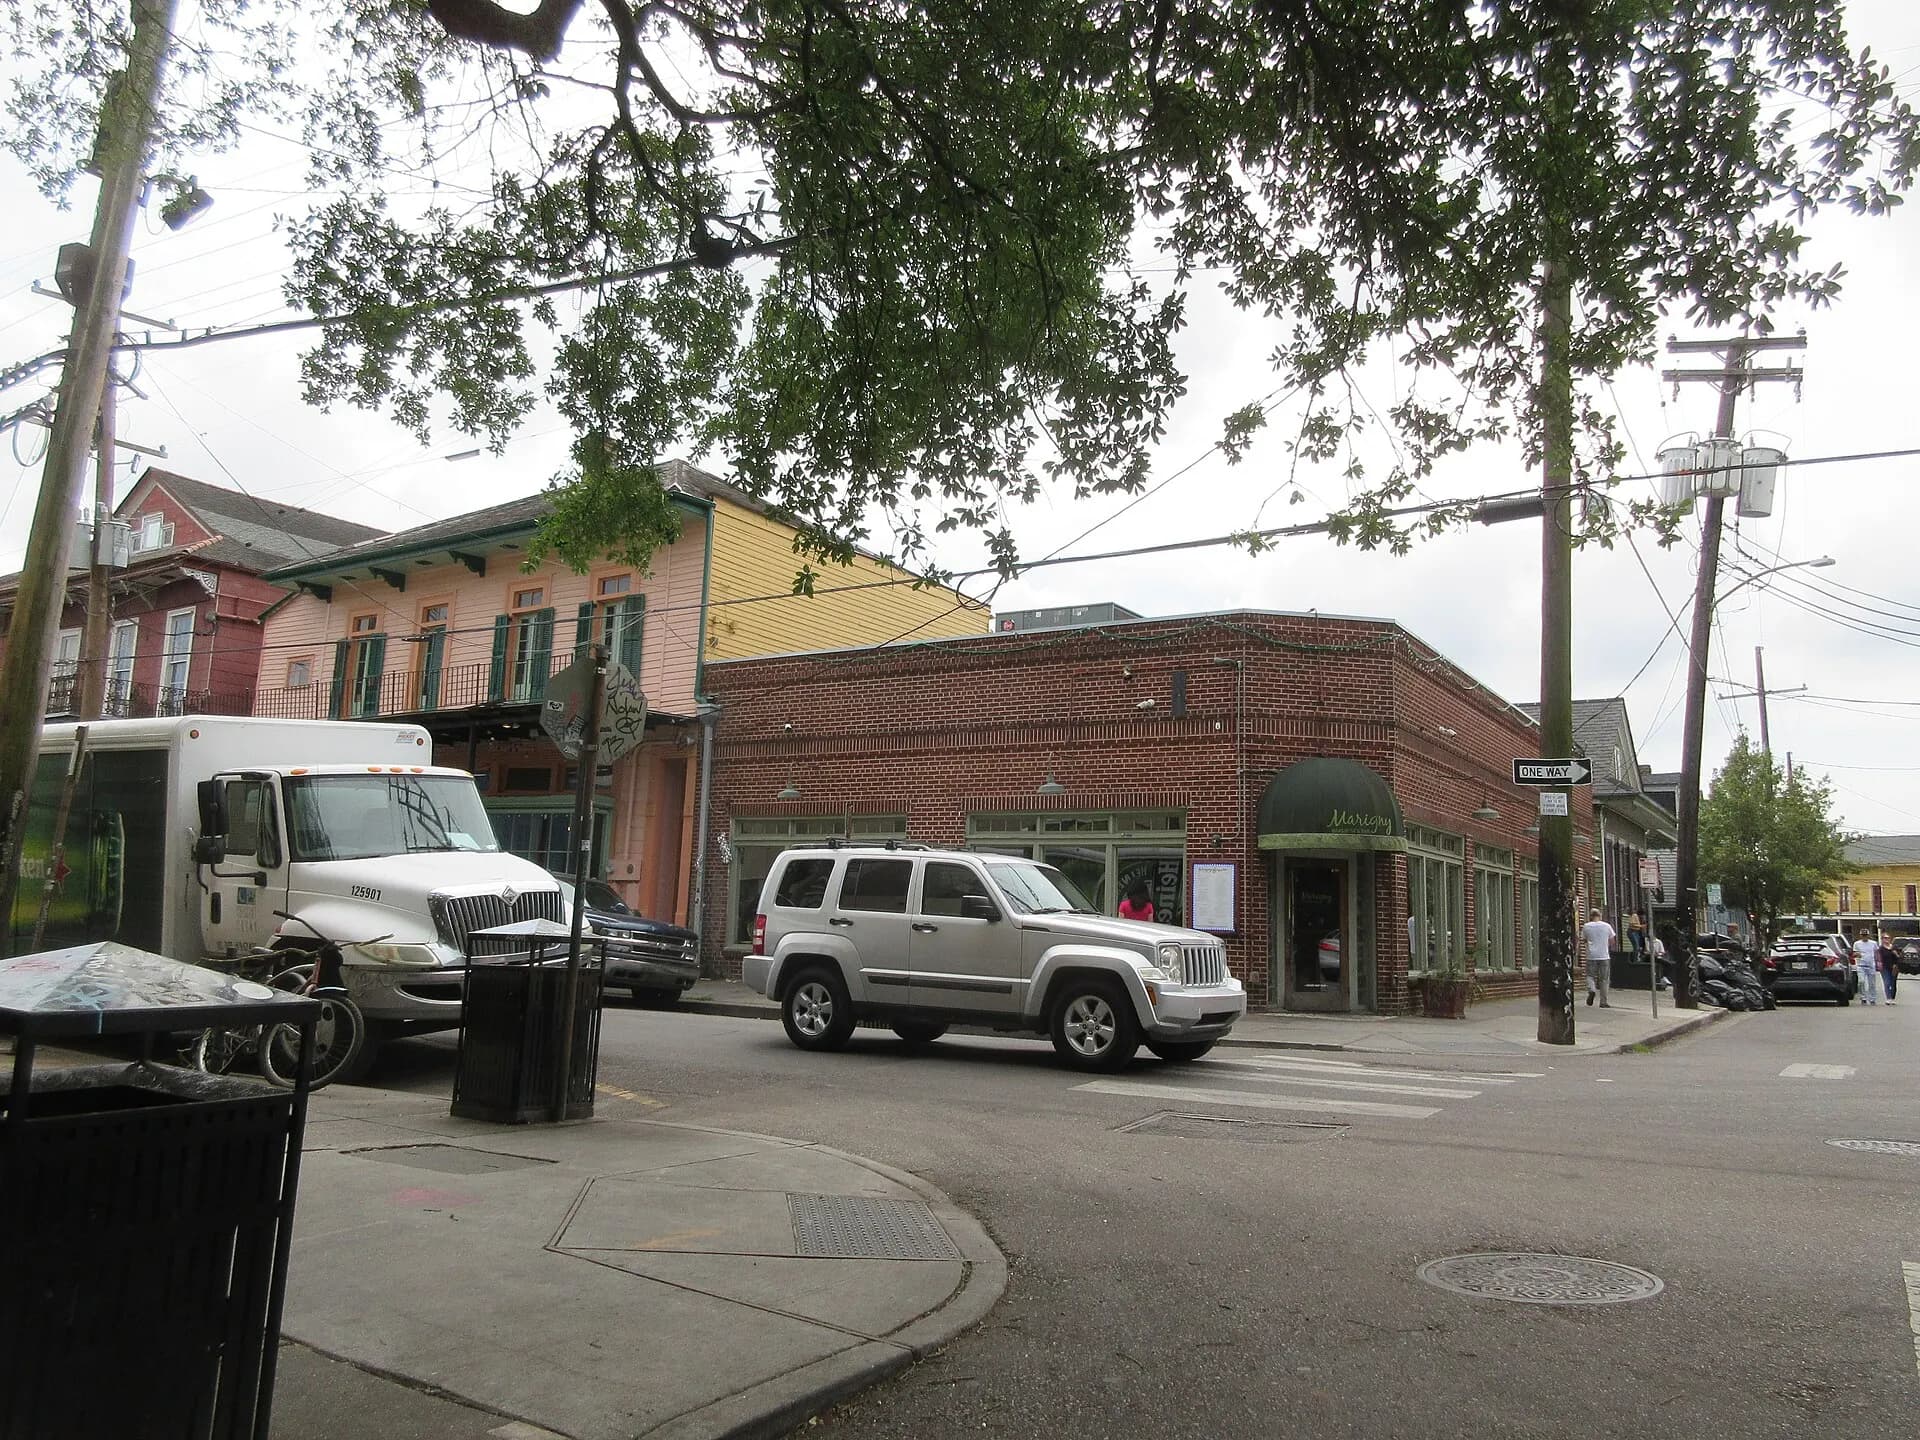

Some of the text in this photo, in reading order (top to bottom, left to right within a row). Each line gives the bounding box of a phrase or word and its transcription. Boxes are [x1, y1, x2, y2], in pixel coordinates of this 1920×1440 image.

[1521, 766, 1569, 777] ONE WAY
[1327, 809, 1392, 836] Marigny
[351, 885, 382, 901] 125907
